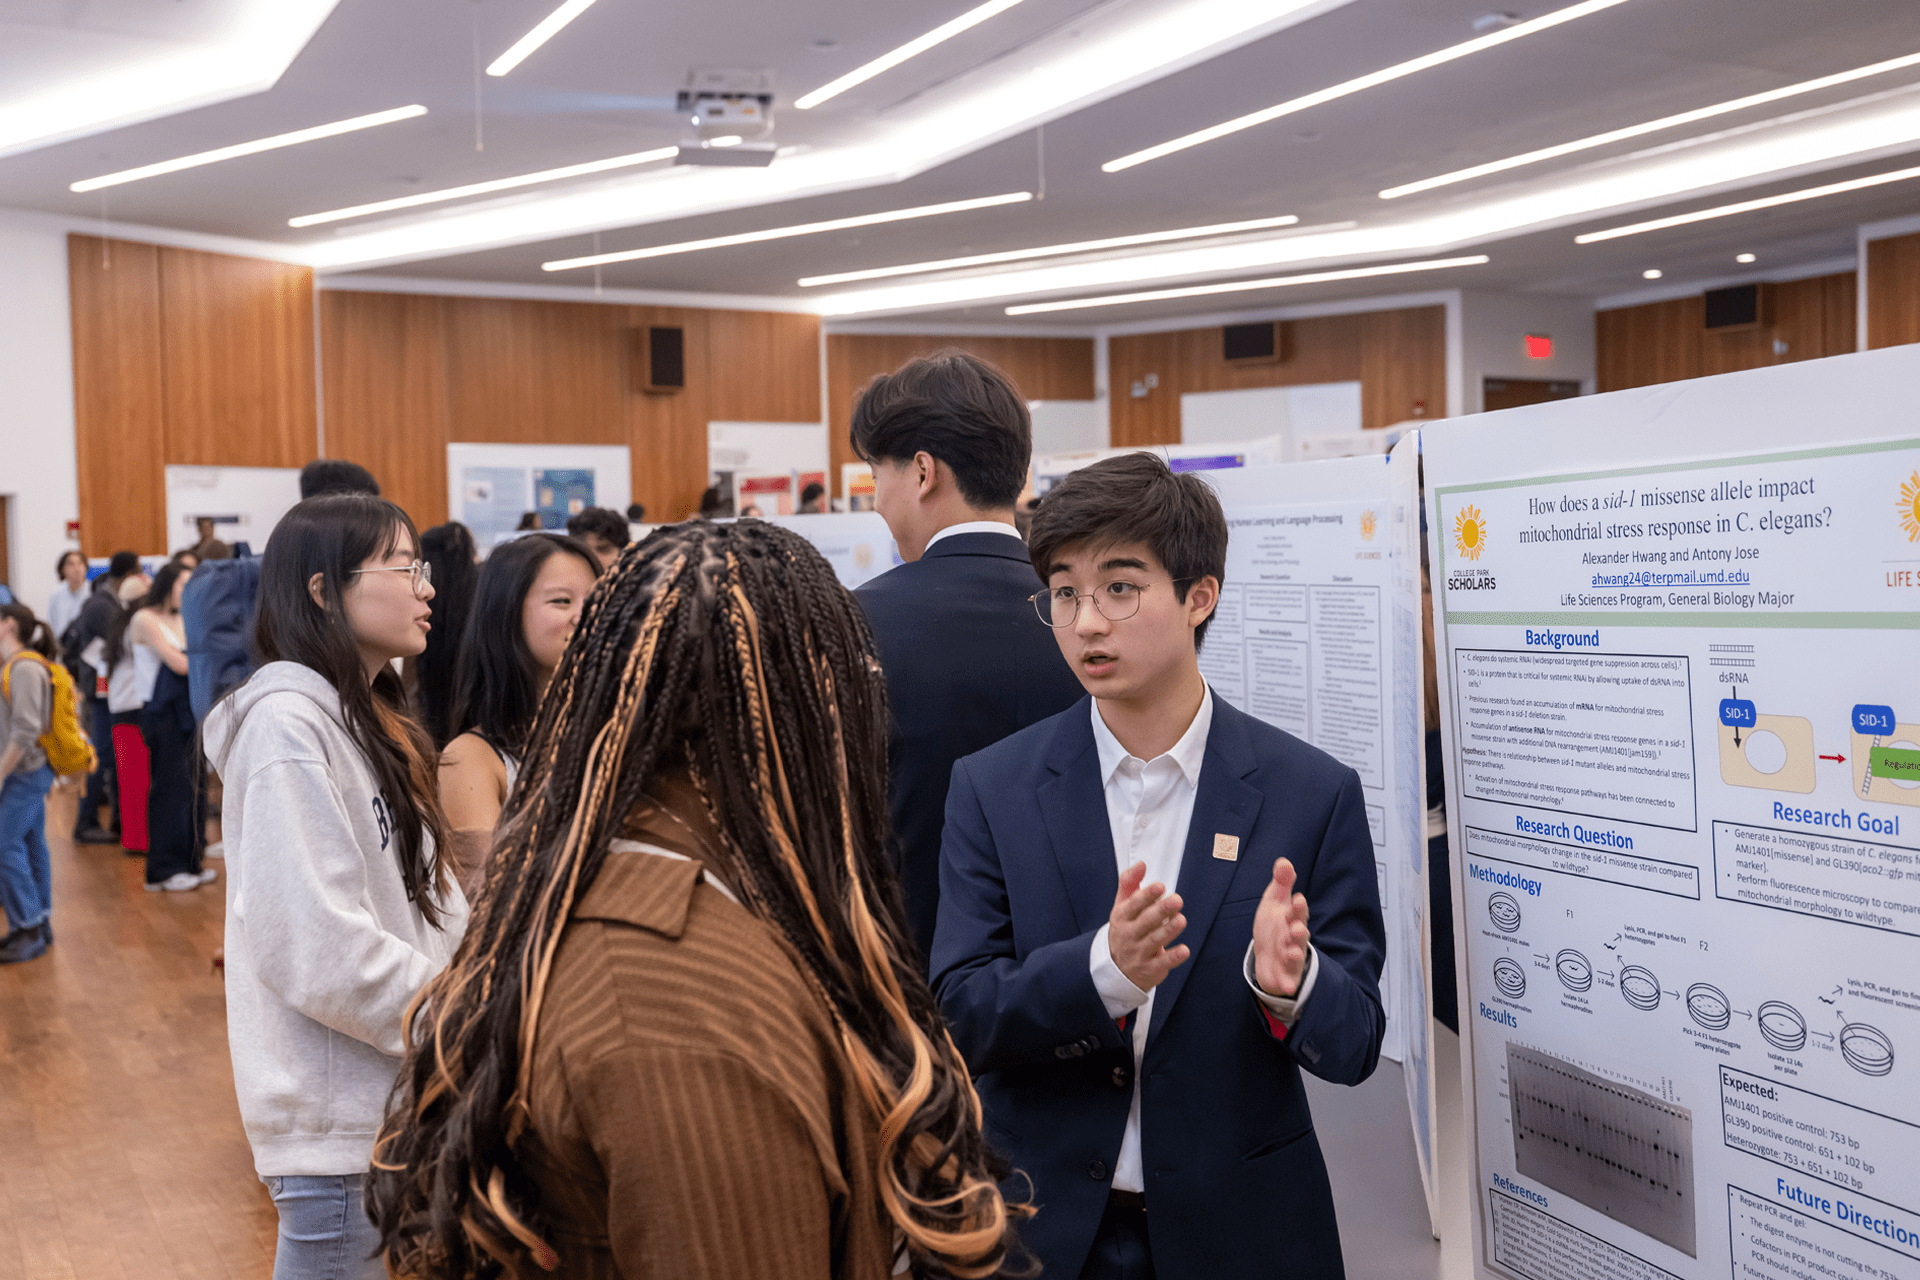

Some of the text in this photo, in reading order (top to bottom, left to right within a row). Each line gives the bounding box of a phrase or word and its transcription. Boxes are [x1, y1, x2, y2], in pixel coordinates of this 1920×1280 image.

[1529, 479, 1814, 515] How does a sid-1 missense allele impact
[1254, 518, 1274, 528] Learning
[1286, 516, 1311, 527] Language
[1312, 514, 1343, 524] Processing
[1520, 507, 1832, 542] mitochondrial stress response in C. elegans?
[1582, 547, 1760, 565] Alexander Hwang and Antony Jose
[1448, 578, 1496, 590] SCHOLARS
[1453, 569, 1490, 579] COLLEGE PARK
[1592, 570, 1750, 588] ahwang24@terpmail.umd.edu
[1887, 571, 1912, 587] LIFE
[1561, 592, 1794, 608] Life Sciences Program, General Biology Major
[1526, 630, 1600, 649] Background
[1719, 672, 1749, 683] dsRNA
[1725, 707, 1750, 720] SID-1
[1859, 714, 1888, 727] SID-1
[1516, 816, 1633, 849] Research Question
[1774, 802, 1899, 835] Research Goal
[1481, 835, 1516, 846] mitochondrial
[1517, 842, 1550, 855] morphology
[1552, 847, 1573, 859] change
[1581, 852, 1592, 861] the
[1593, 854, 1607, 864] sid-1
[1609, 858, 1638, 870] missense
[1639, 864, 1658, 873] strain
[1659, 868, 1693, 880] compared
[1734, 829, 1770, 842] Generate
[1779, 836, 1830, 851] homozygous
[1831, 844, 1855, 854] strain
[1857, 847, 1866, 856] of
[1878, 851, 1913, 864] elegans
[1470, 865, 1542, 896] Methodology
[1552, 861, 1589, 873] to wildtype?
[1737, 873, 1768, 886] Perform
[1770, 879, 1820, 896] fluorescence
[1822, 890, 1870, 906] microscopy
[1872, 898, 1881, 907] to
[1566, 909, 1573, 918] F1
[1738, 890, 1895, 926] mitochondrial morphology to wildtype.
[1700, 940, 1708, 951] F2
[1480, 1003, 1517, 1028] Results
[1723, 1074, 1778, 1101] Expected:
[1724, 1096, 1860, 1150] AMJ1401 positive control: 753 bp
[1725, 1114, 1750, 1130] GL390
[1752, 1125, 1783, 1141] positive
[1784, 1136, 1816, 1153] control:
[1818, 1146, 1834, 1160] 651
[1844, 1155, 1860, 1169] 102
[1863, 1161, 1875, 1175] bp
[1726, 1133, 1781, 1158] Heterozygote:
[1783, 1152, 1798, 1165] 753
[1808, 1161, 1823, 1175] 651
[1833, 1170, 1849, 1184] 102
[1851, 1176, 1863, 1190] bp
[1493, 1174, 1548, 1208] References
[1740, 1195, 1808, 1228] Repeat PCR and gel:
[1777, 1178, 1920, 1248] Future Direction
[1750, 1216, 1878, 1276] The digest enzyme is not cutting the
[1751, 1235, 1836, 1278] Cofactors in PCR product
[1752, 1250, 1789, 1273] PCR should
